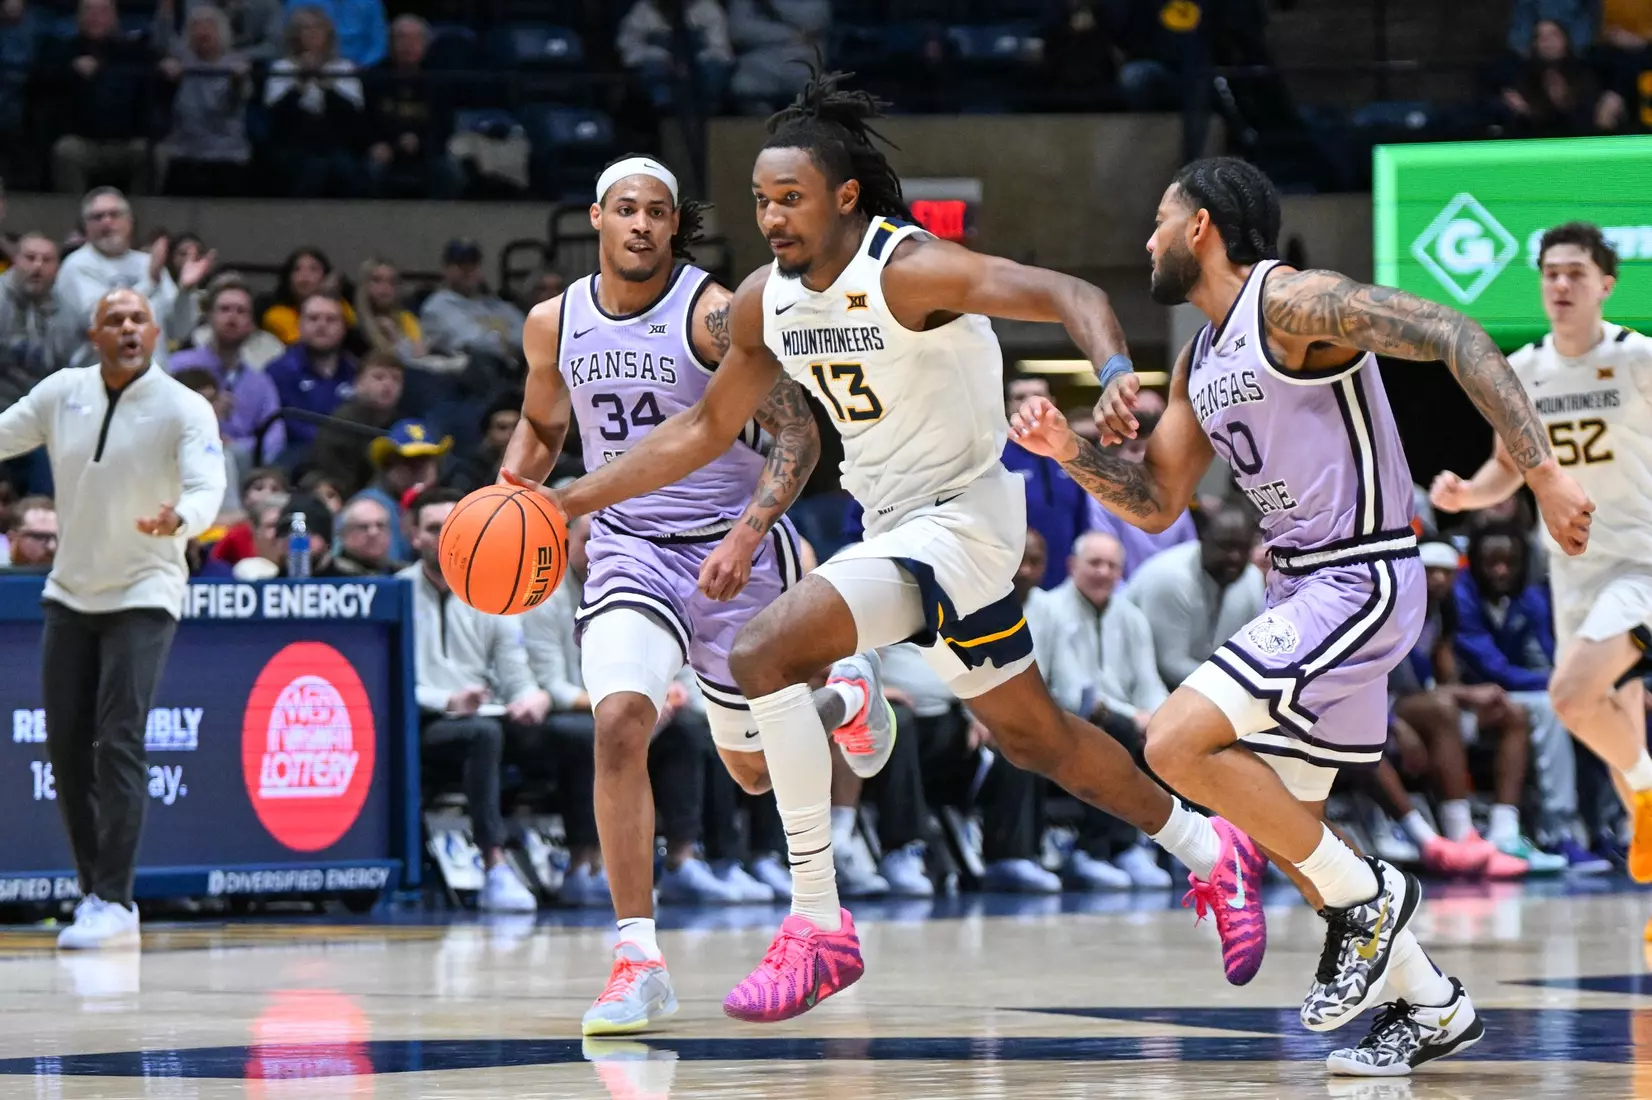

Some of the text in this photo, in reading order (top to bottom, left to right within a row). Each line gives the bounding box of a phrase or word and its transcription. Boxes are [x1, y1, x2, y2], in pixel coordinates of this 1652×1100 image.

[782, 326, 885, 356] MOUNTAINEERS
[570, 351, 677, 388] KANSAS
[809, 362, 884, 422] 13
[1535, 389, 1620, 415] MOUNTAINEERS
[591, 392, 667, 441] 34
[1547, 418, 1614, 467] 52
[1245, 479, 1298, 514] ATE
[524, 546, 552, 608] ELITE
[263, 583, 377, 618] ENERGY
[225, 868, 325, 893] DIVERSIFIED
[325, 866, 390, 890] ENERGY
